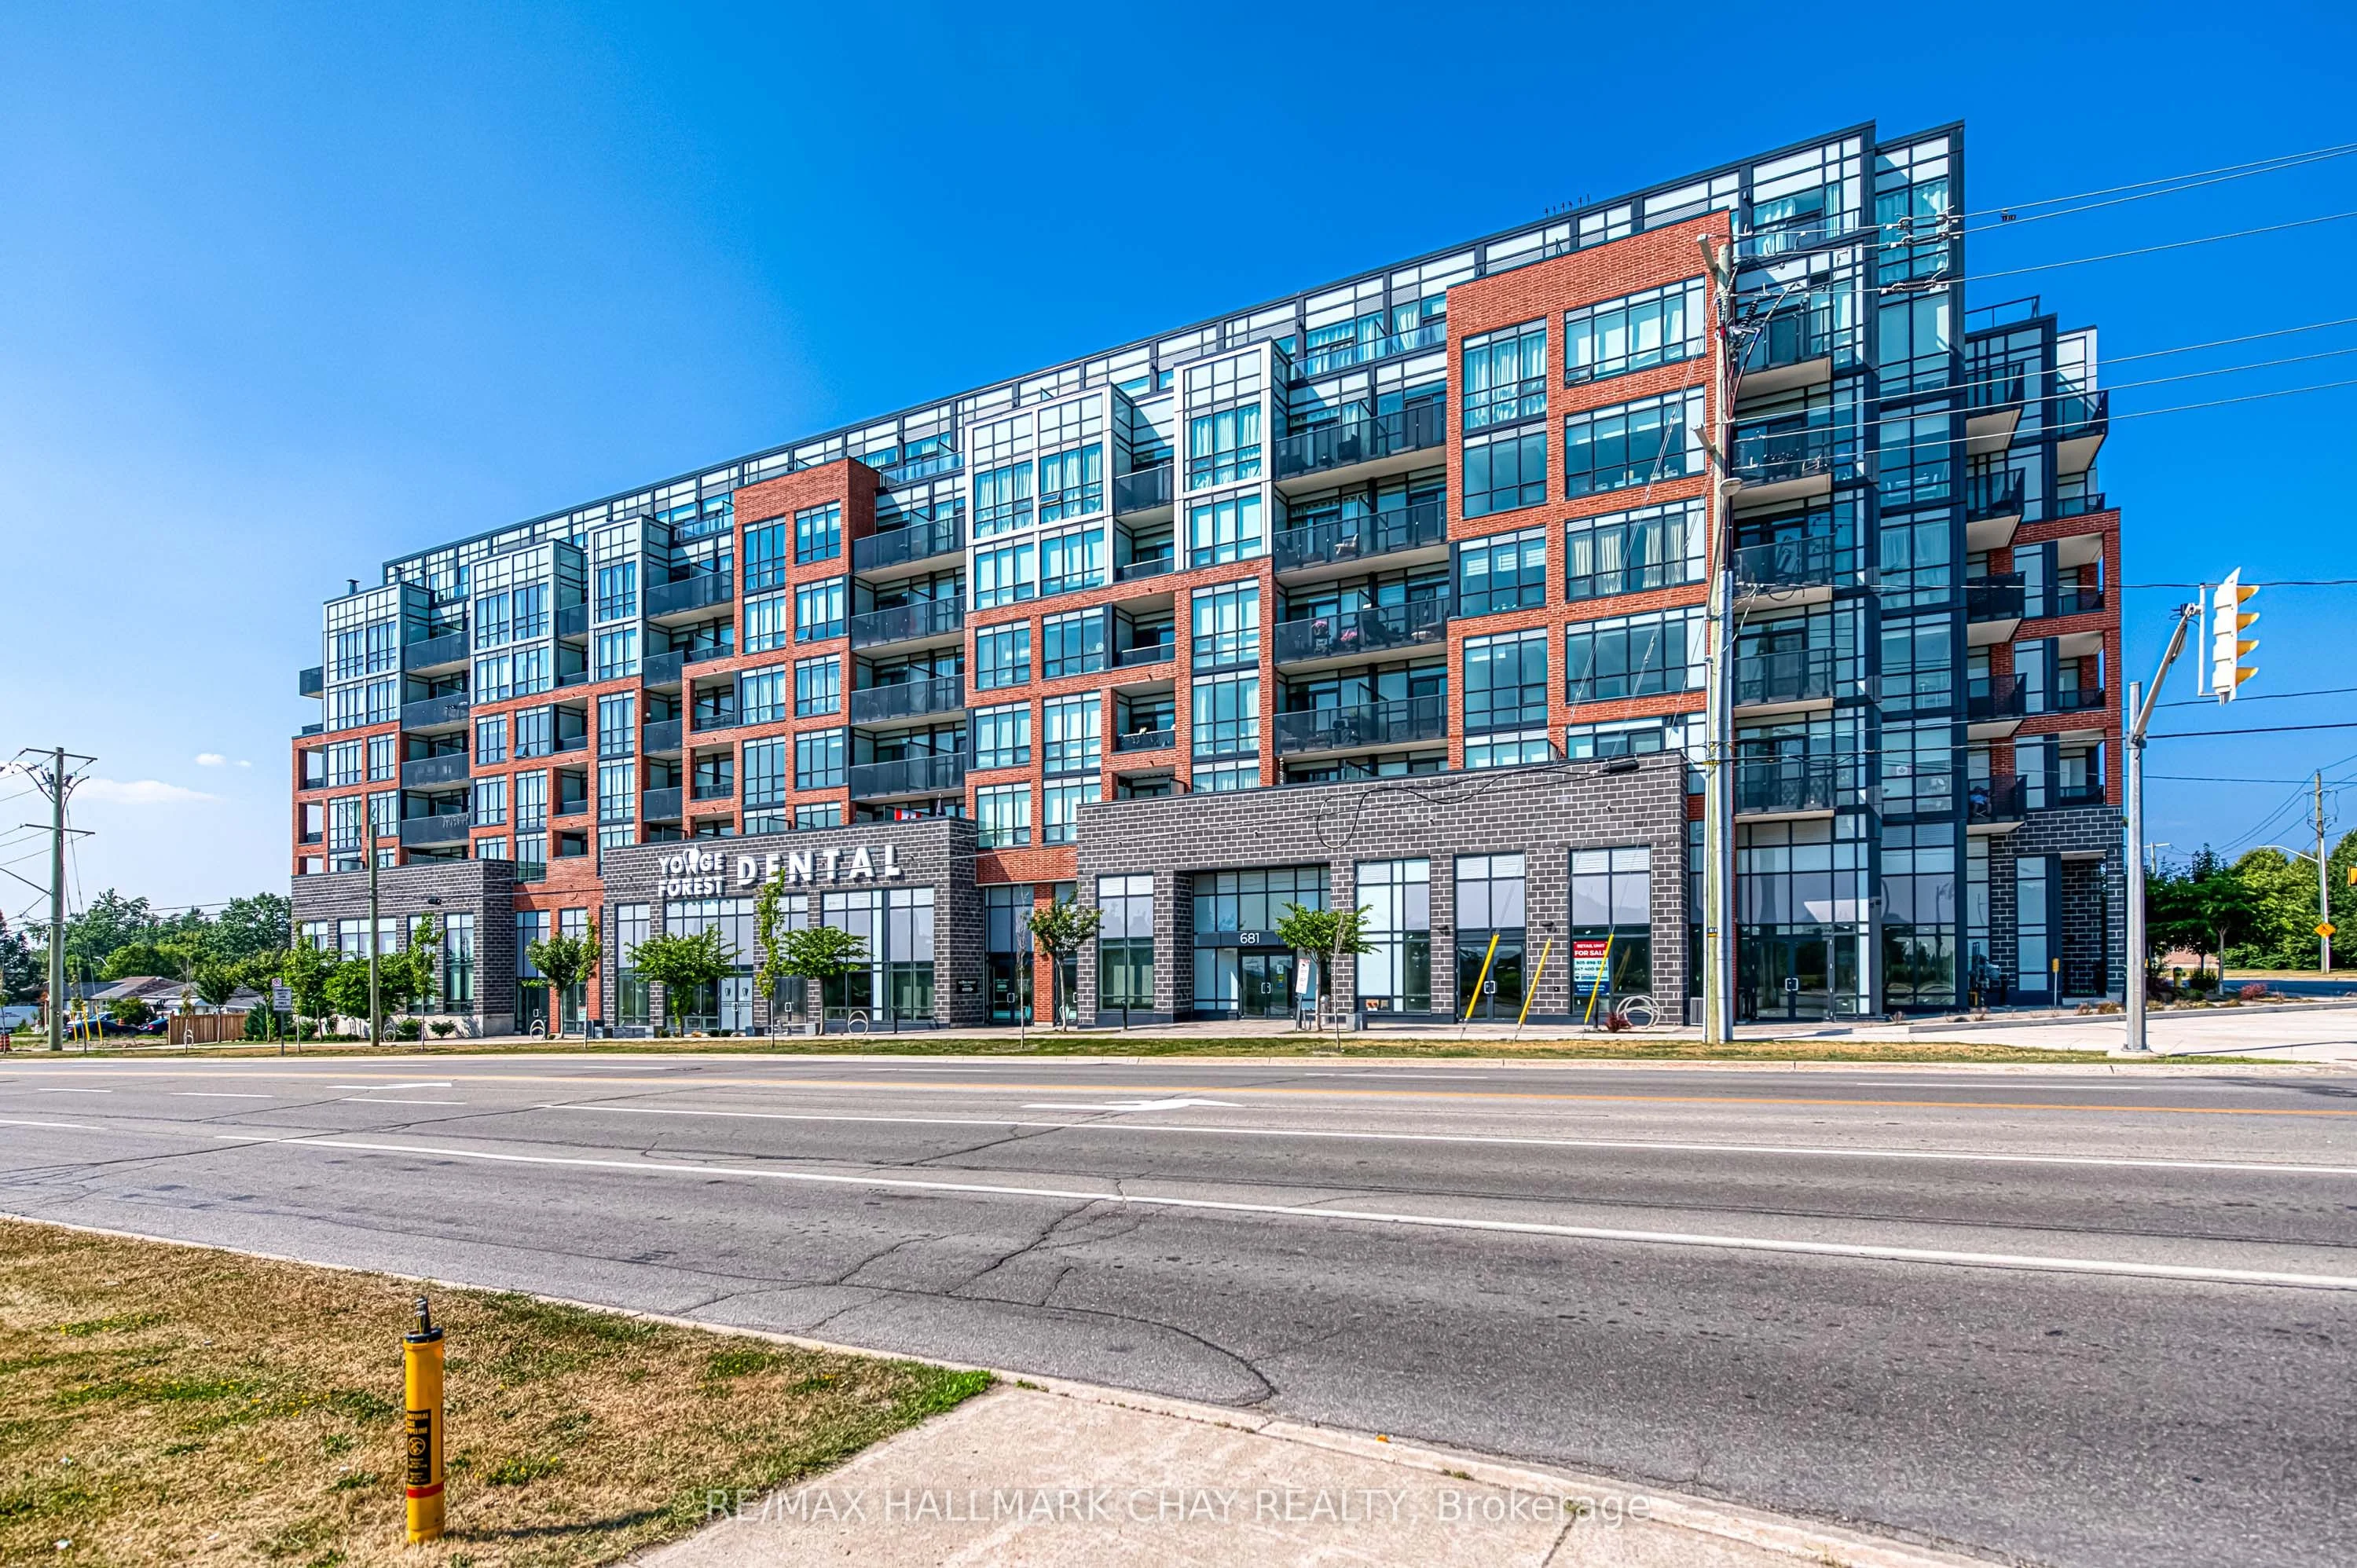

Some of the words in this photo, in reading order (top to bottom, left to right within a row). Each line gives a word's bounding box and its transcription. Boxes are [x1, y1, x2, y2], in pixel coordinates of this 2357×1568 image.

[737, 844, 902, 886] DENTAL
[658, 876, 723, 897] FOREST
[1240, 932, 1259, 944] 681
